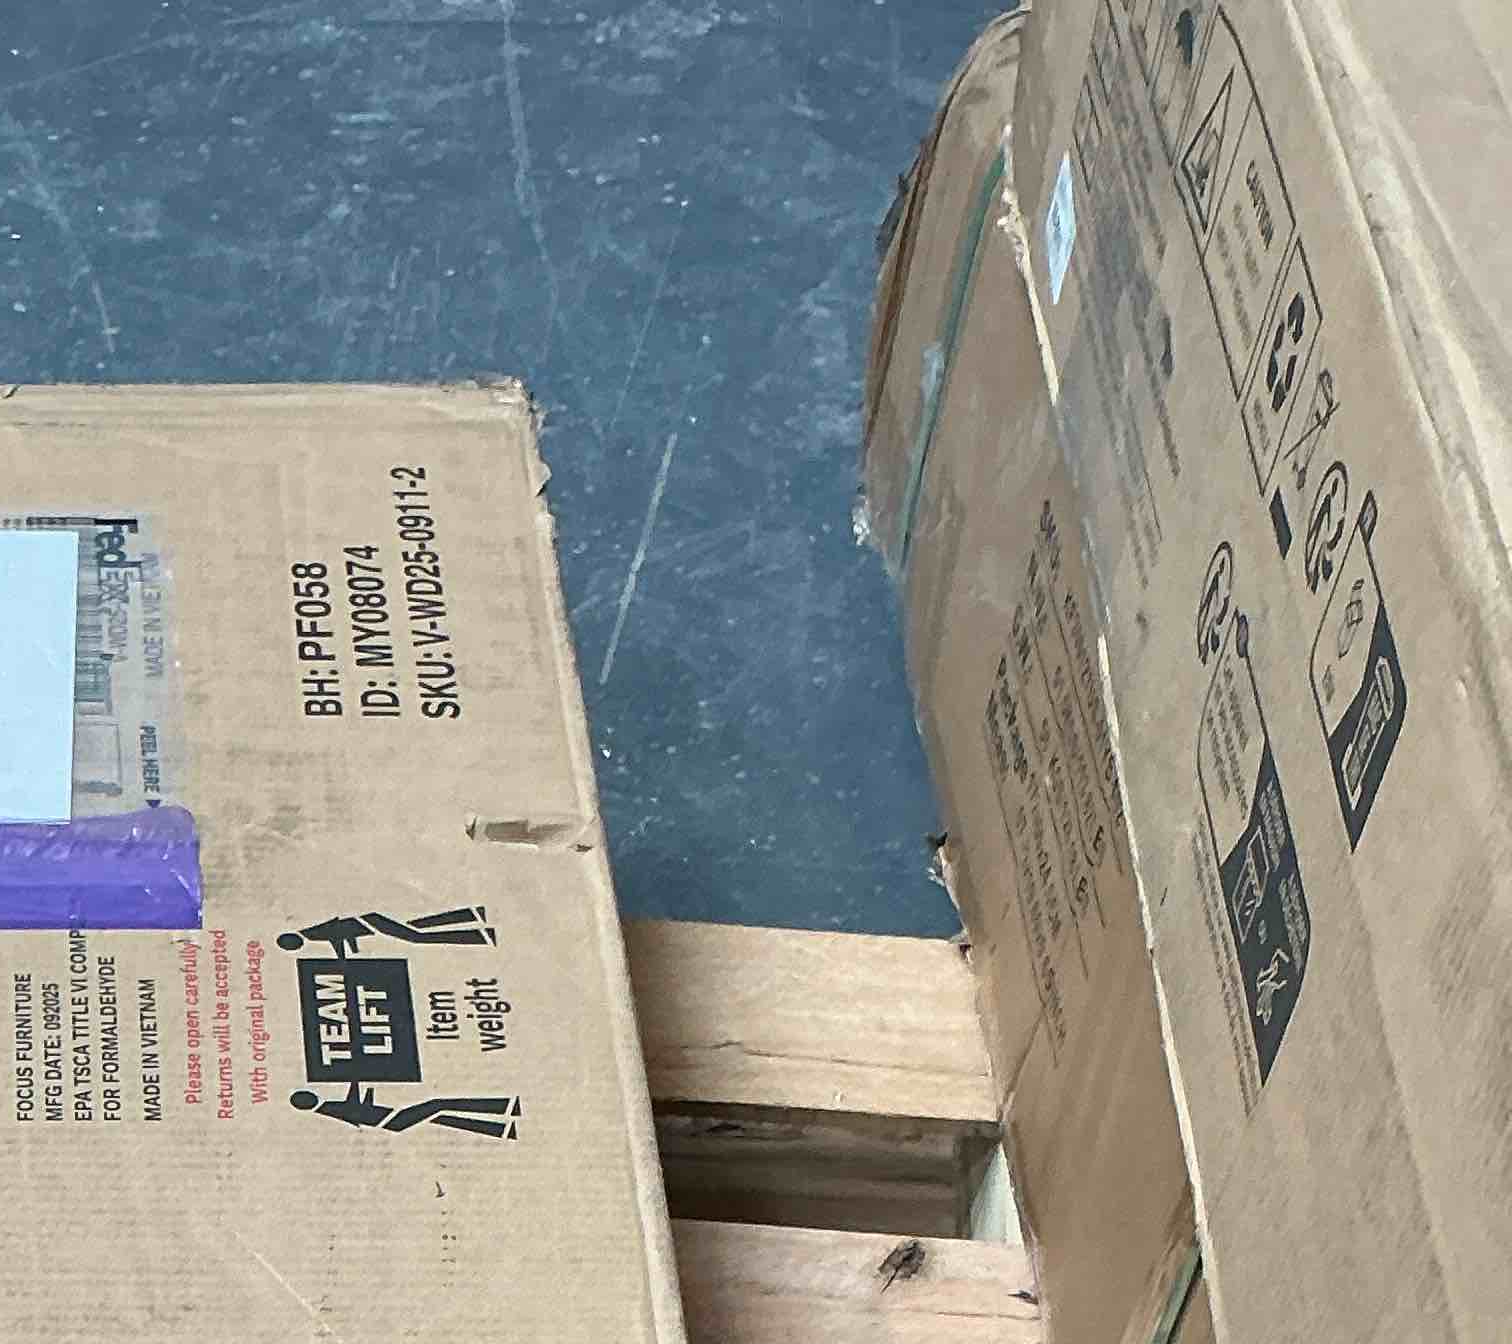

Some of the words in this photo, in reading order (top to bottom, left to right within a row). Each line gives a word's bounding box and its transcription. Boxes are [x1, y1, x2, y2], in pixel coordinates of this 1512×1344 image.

[143, 616, 161, 633] IN
[343, 545, 395, 667] MY08074
[144, 636, 164, 678] MADE
[360, 681, 401, 717] ID:
[140, 726, 157, 762] PEEL
[143, 762, 160, 793] HERE
[69, 930, 88, 973] COMP
[208, 929, 229, 998] accepted
[246, 940, 267, 1001] package
[42, 983, 60, 1031] 092025
[71, 978, 88, 993] VI
[14, 973, 32, 1061] FURNITURE
[72, 997, 90, 1041] TITLE
[98, 956, 120, 1083] FORMALDEHYDE
[138, 979, 157, 1049] VIETNAM
[186, 1011, 203, 1049] open
[212, 1003, 230, 1020] be
[246, 1005, 270, 1062] original
[314, 974, 352, 1067] TEAM
[356, 985, 393, 1054] LIFT
[426, 991, 459, 1040] Item
[464, 978, 511, 1052] weight
[44, 1035, 62, 1086] DATE:
[142, 1053, 158, 1068] IN
[212, 1023, 231, 1053] will
[73, 1043, 91, 1086] TSCA
[184, 1054, 202, 1105] Please
[248, 1066, 268, 1105] With
[16, 1067, 34, 1121] FOCUS
[45, 1088, 63, 1121] MFG
[75, 1090, 92, 1121] EPA
[104, 1090, 121, 1121] FOR
[144, 1072, 162, 1121] MADE
[217, 1056, 233, 1120] Returns
